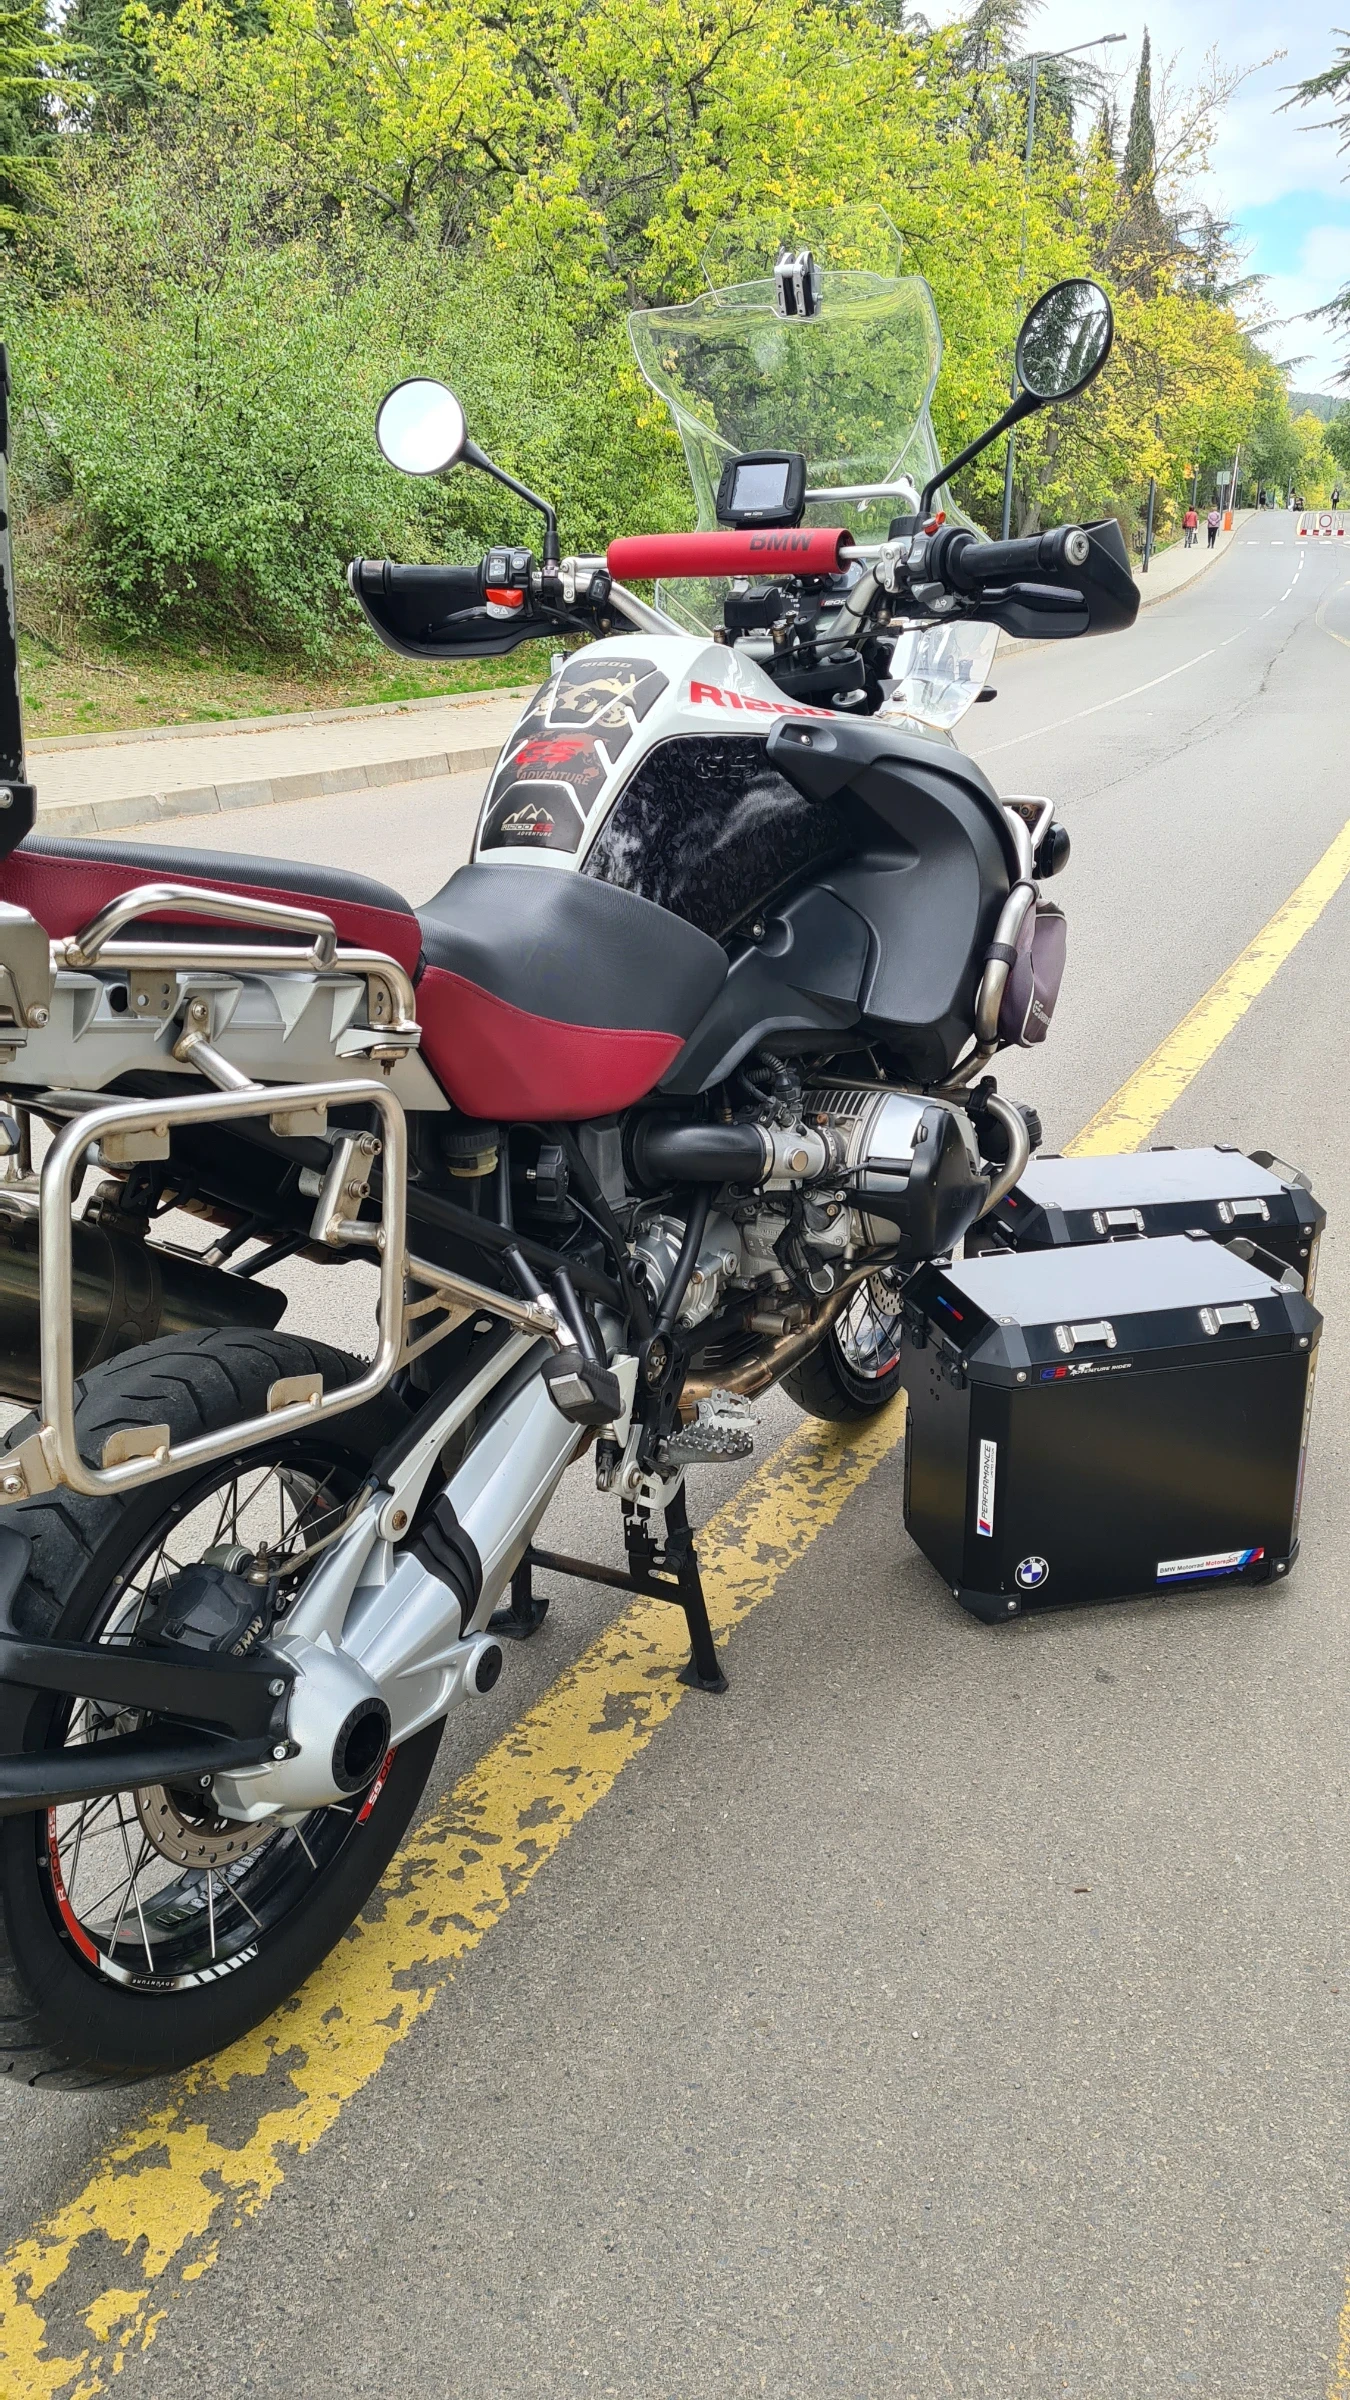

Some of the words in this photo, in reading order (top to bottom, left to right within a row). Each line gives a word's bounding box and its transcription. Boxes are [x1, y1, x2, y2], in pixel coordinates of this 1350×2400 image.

[749, 531, 815, 551] BMW
[689, 680, 837, 717] R1200
[515, 741, 584, 764] GS
[519, 770, 591, 785] ADVENTURE
[533, 822, 554, 832] GS
[1041, 1366, 1067, 1380] GS
[1111, 1363, 1132, 1371] RIDER
[982, 1444, 991, 1520] PERFORMANCE
[1177, 1562, 1204, 1571] Motorrad
[1205, 1556, 1238, 1567] Motorsport
[230, 1615, 263, 1656] BMW
[131, 1978, 175, 1988] ADVENTURE
